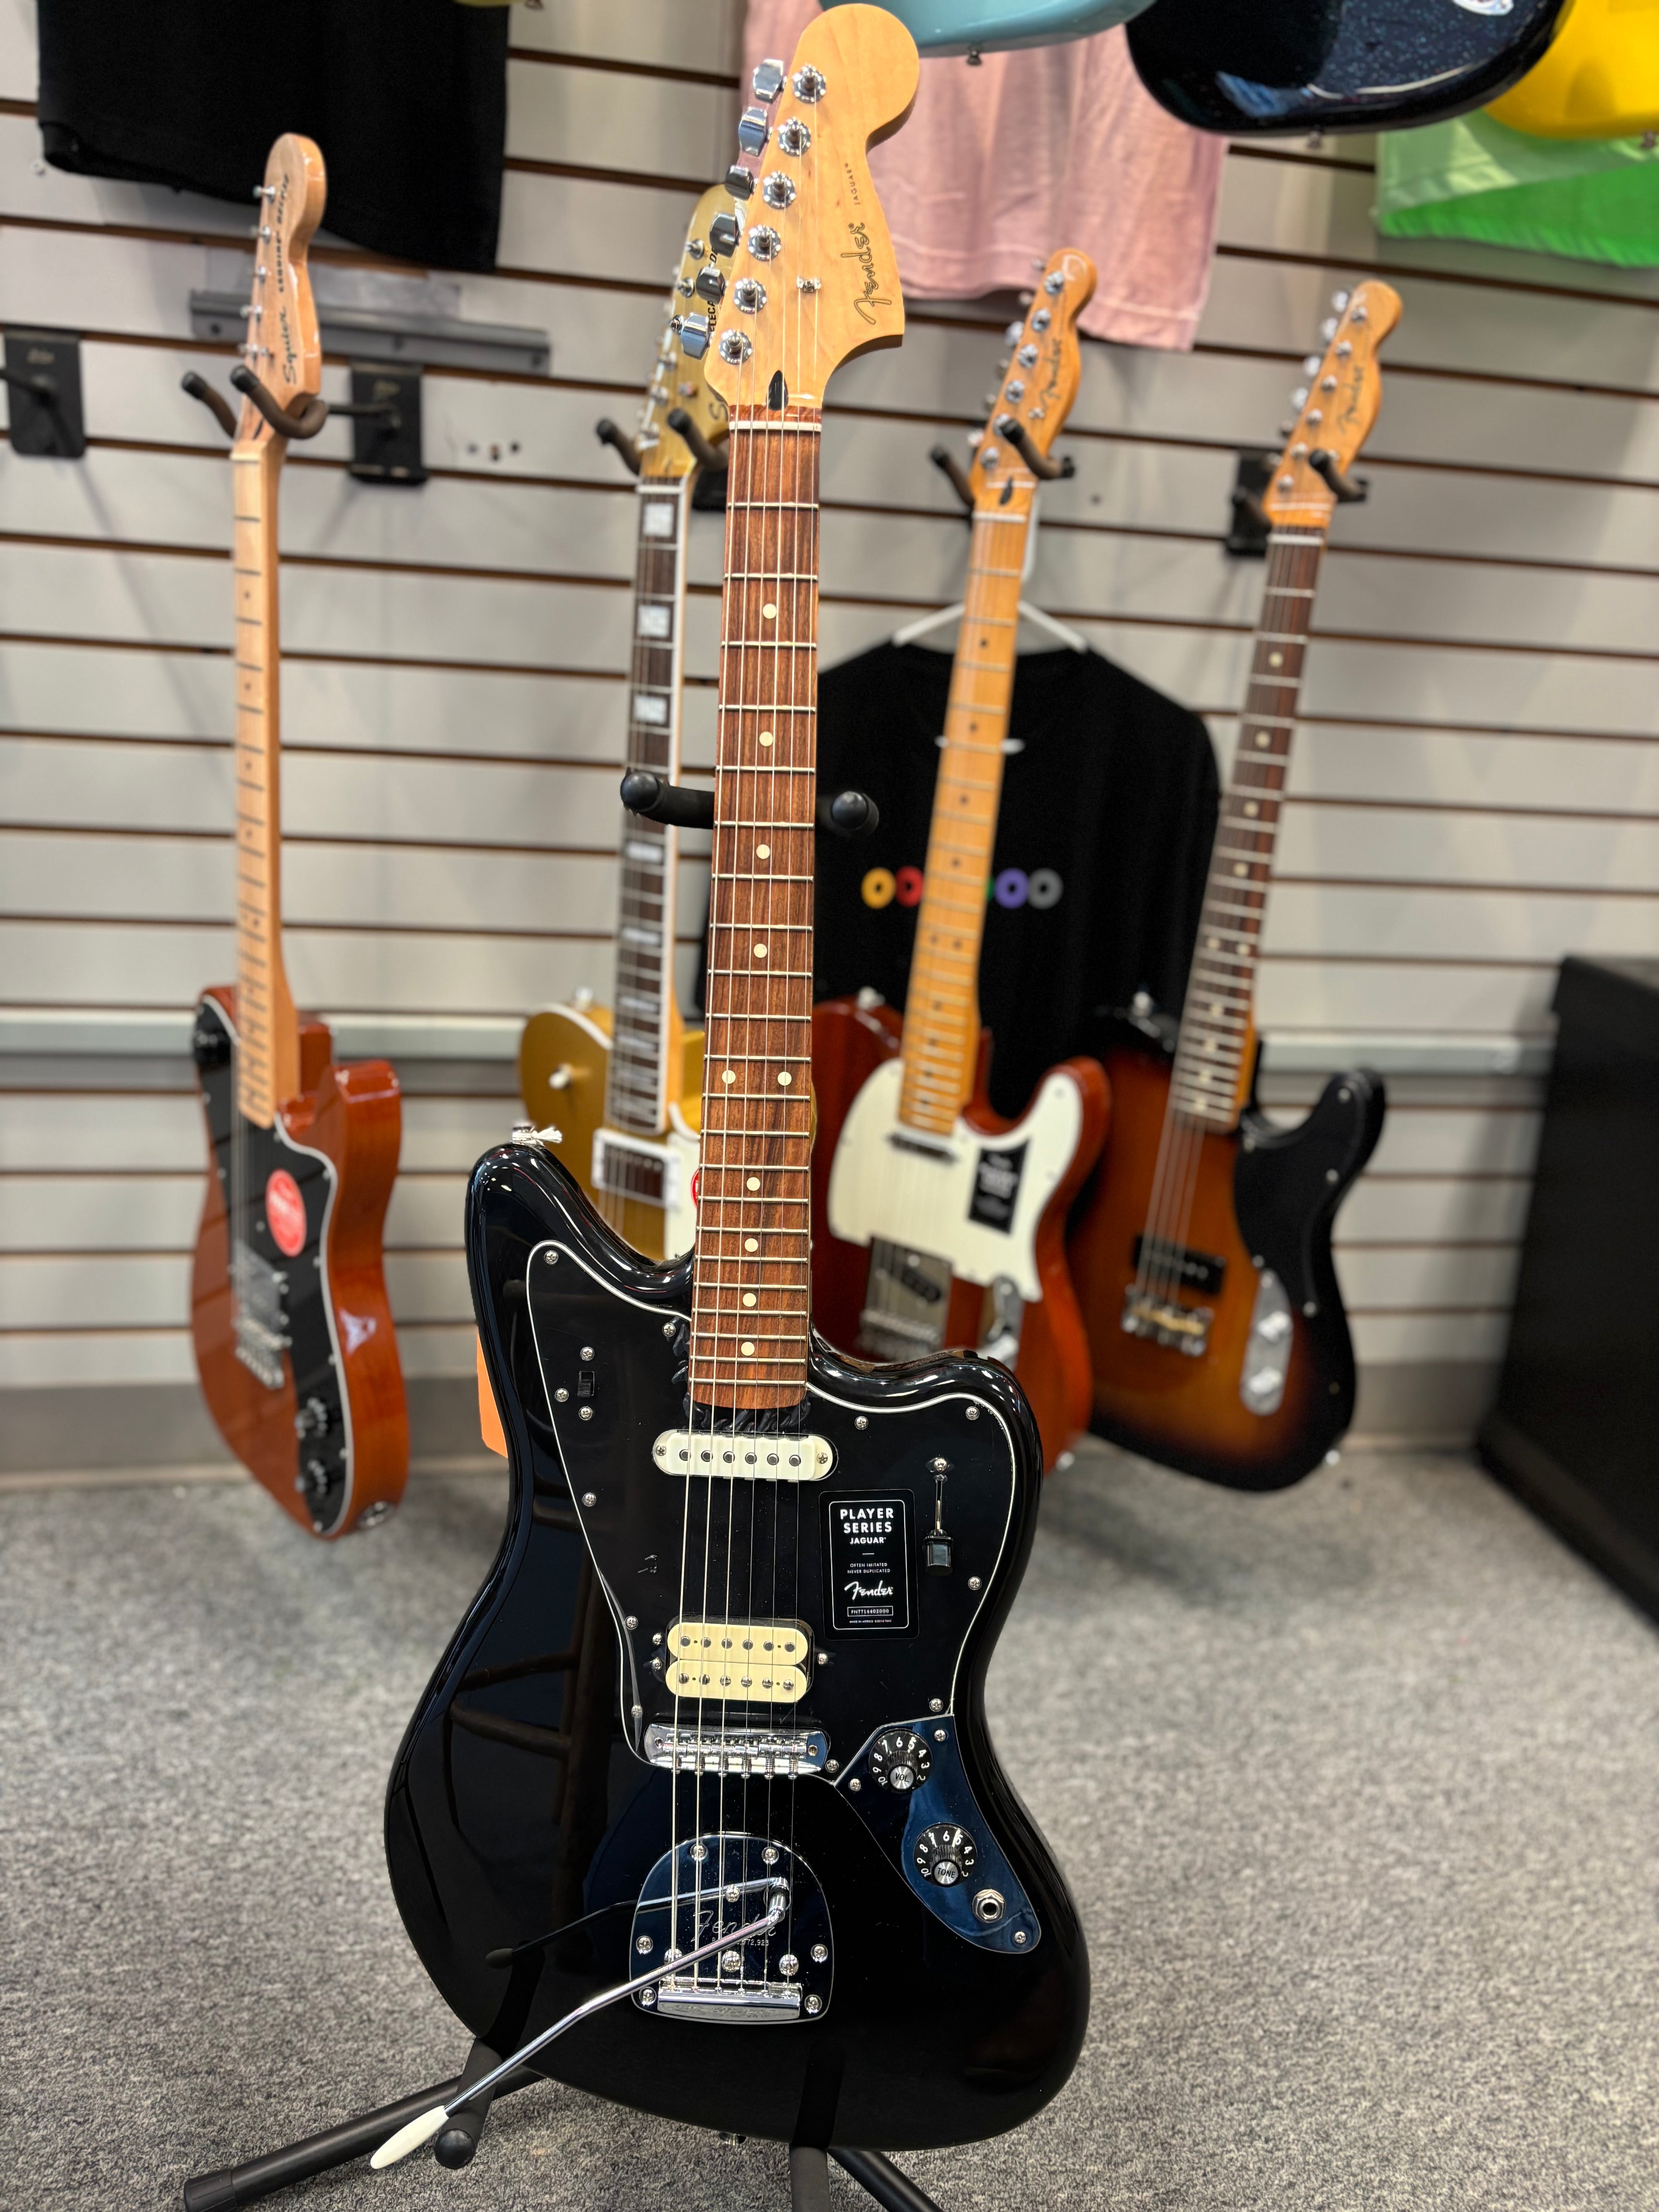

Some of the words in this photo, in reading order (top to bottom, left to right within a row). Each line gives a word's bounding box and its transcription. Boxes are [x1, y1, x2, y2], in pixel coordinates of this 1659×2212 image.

[841, 222, 892, 325] Fender
[283, 304, 297, 385] Squier
[840, 1508, 894, 1520] PLAYER
[843, 1522, 892, 1534] SERIES
[844, 1580, 893, 1600] Fender
[874, 1753, 883, 1761] 8
[896, 1736, 903, 1747] 6
[919, 1749, 926, 1759] 4
[895, 1772, 909, 1783] VOL
[919, 1844, 928, 1853] 8
[943, 1831, 950, 1841] 6
[938, 1868, 955, 1878] TONE
